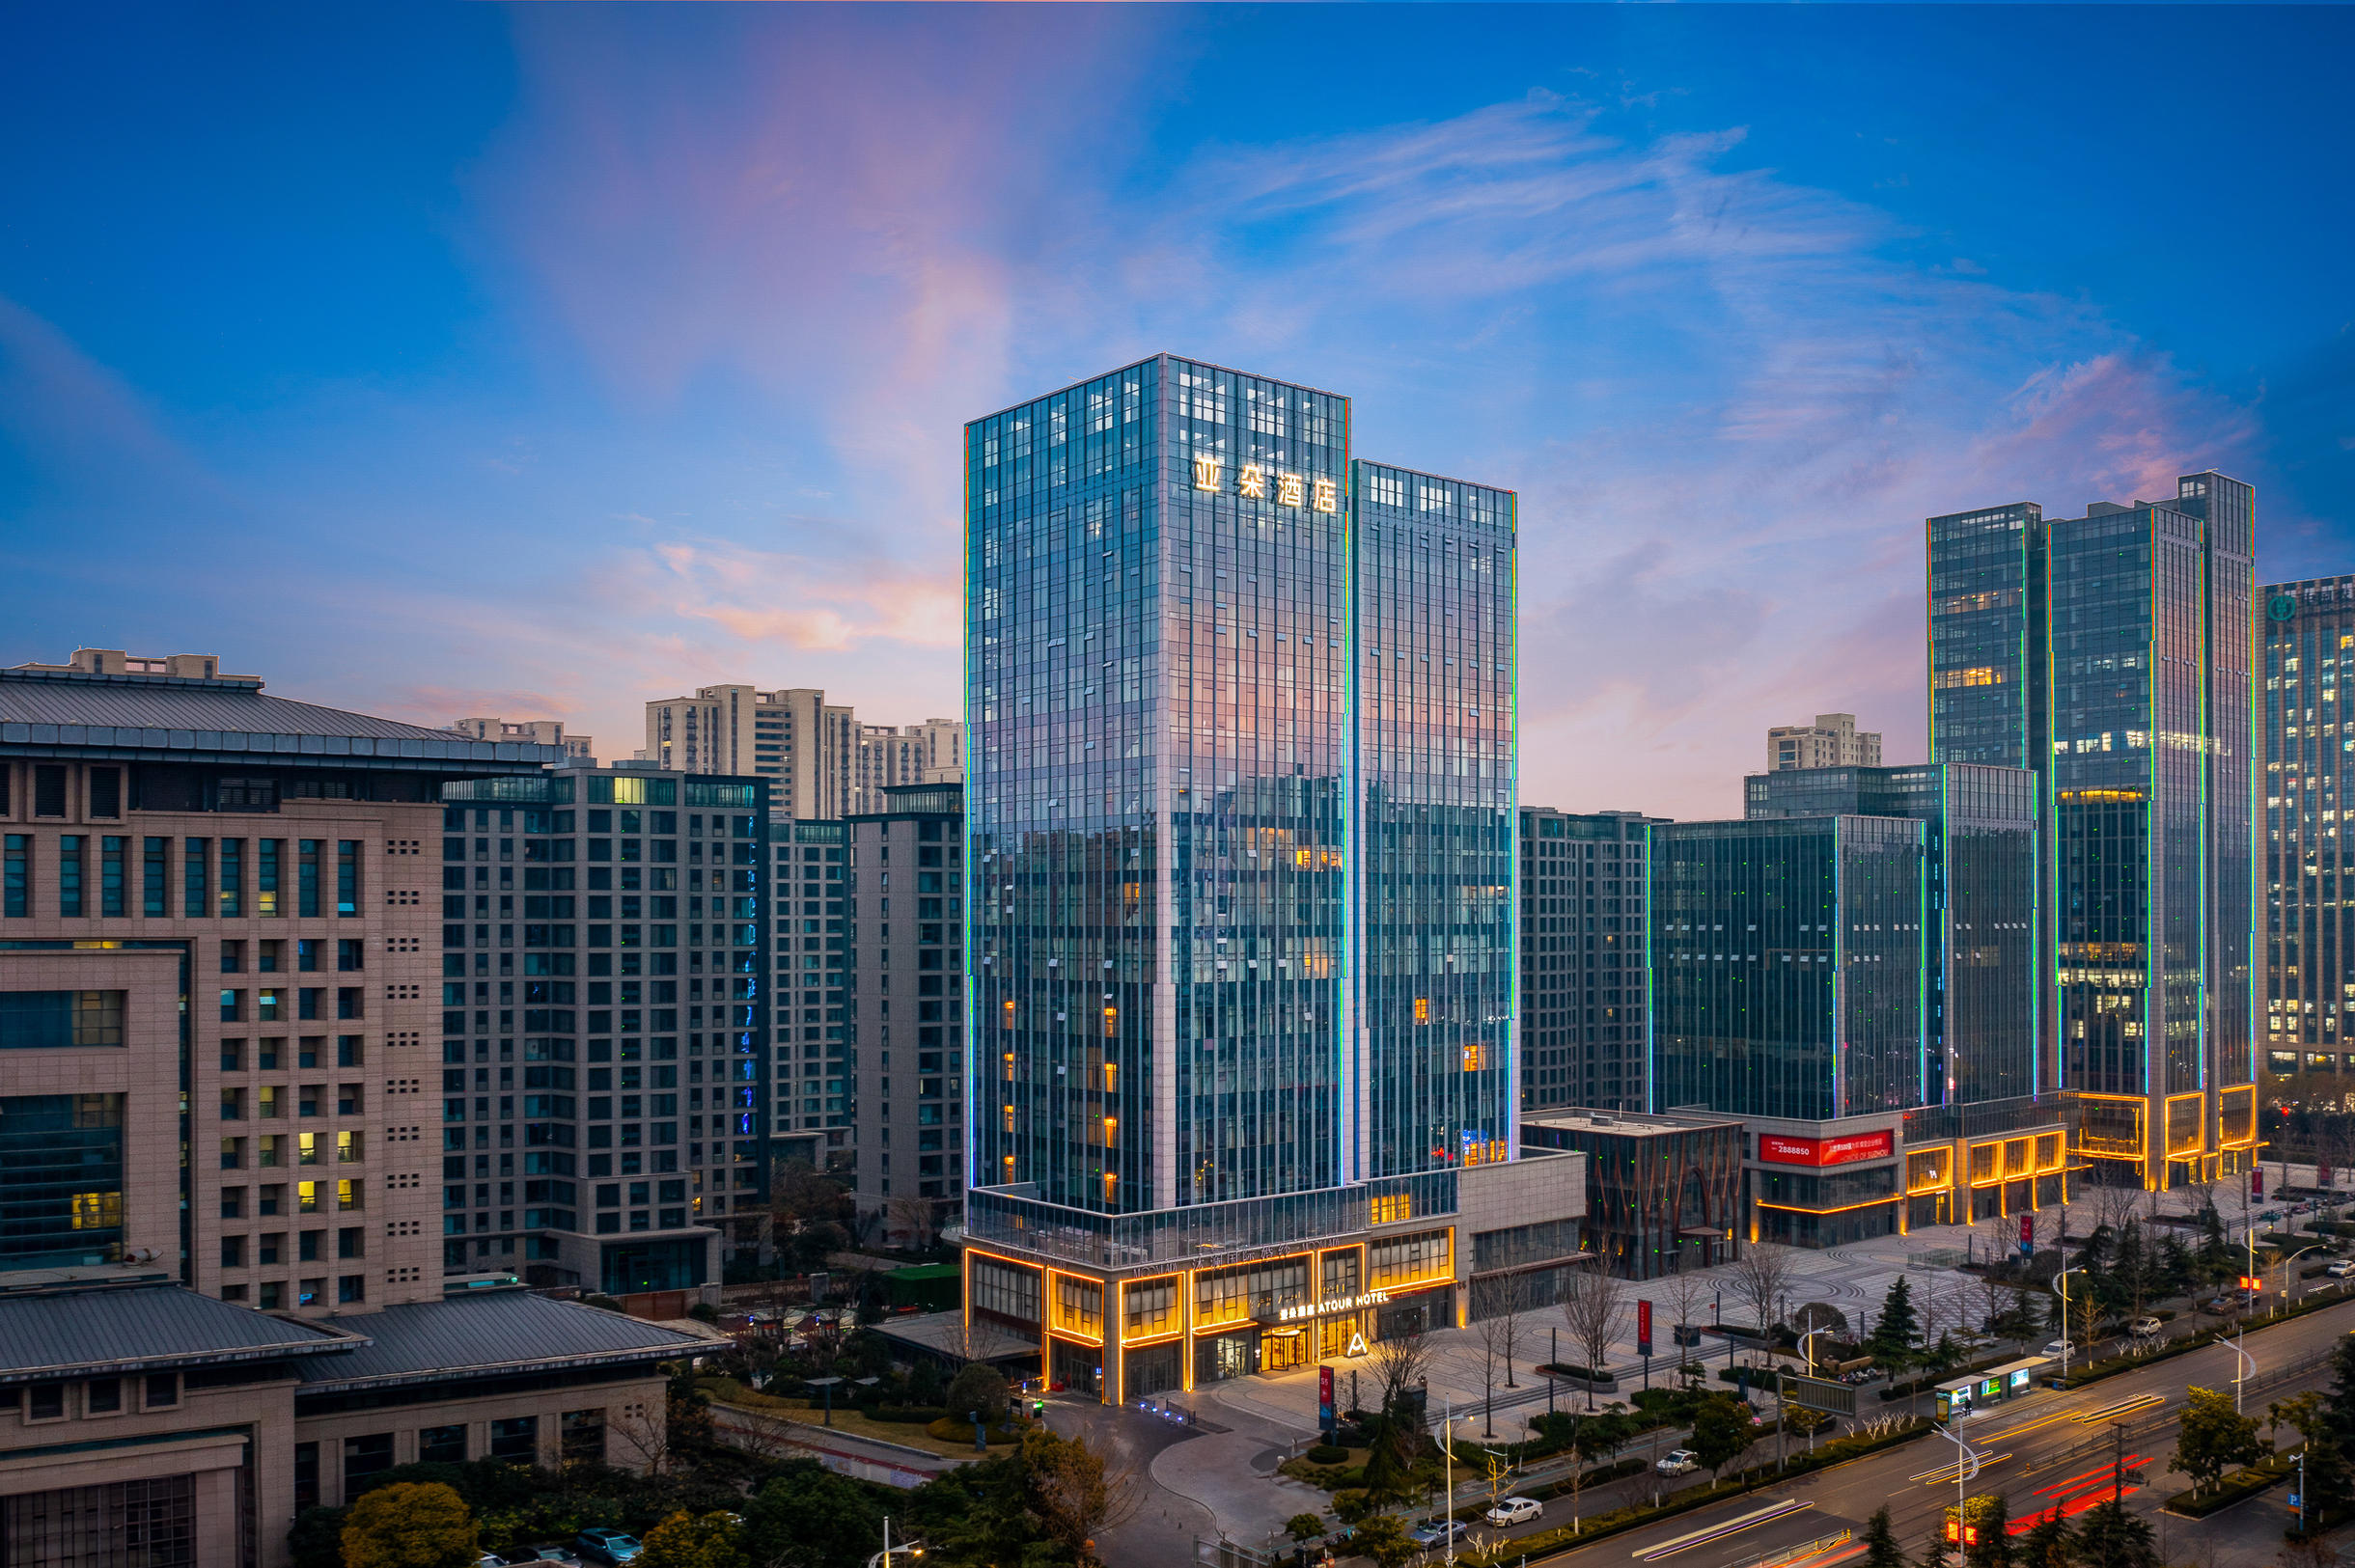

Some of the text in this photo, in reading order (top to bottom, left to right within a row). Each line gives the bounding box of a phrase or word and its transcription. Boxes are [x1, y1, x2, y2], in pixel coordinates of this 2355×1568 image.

[1196, 457, 1337, 513] 亚朵酒店
[1778, 1145, 1810, 1156] 2888850
[1318, 1297, 1353, 1314] ATOUR
[1356, 1291, 1390, 1307] HOTEL
